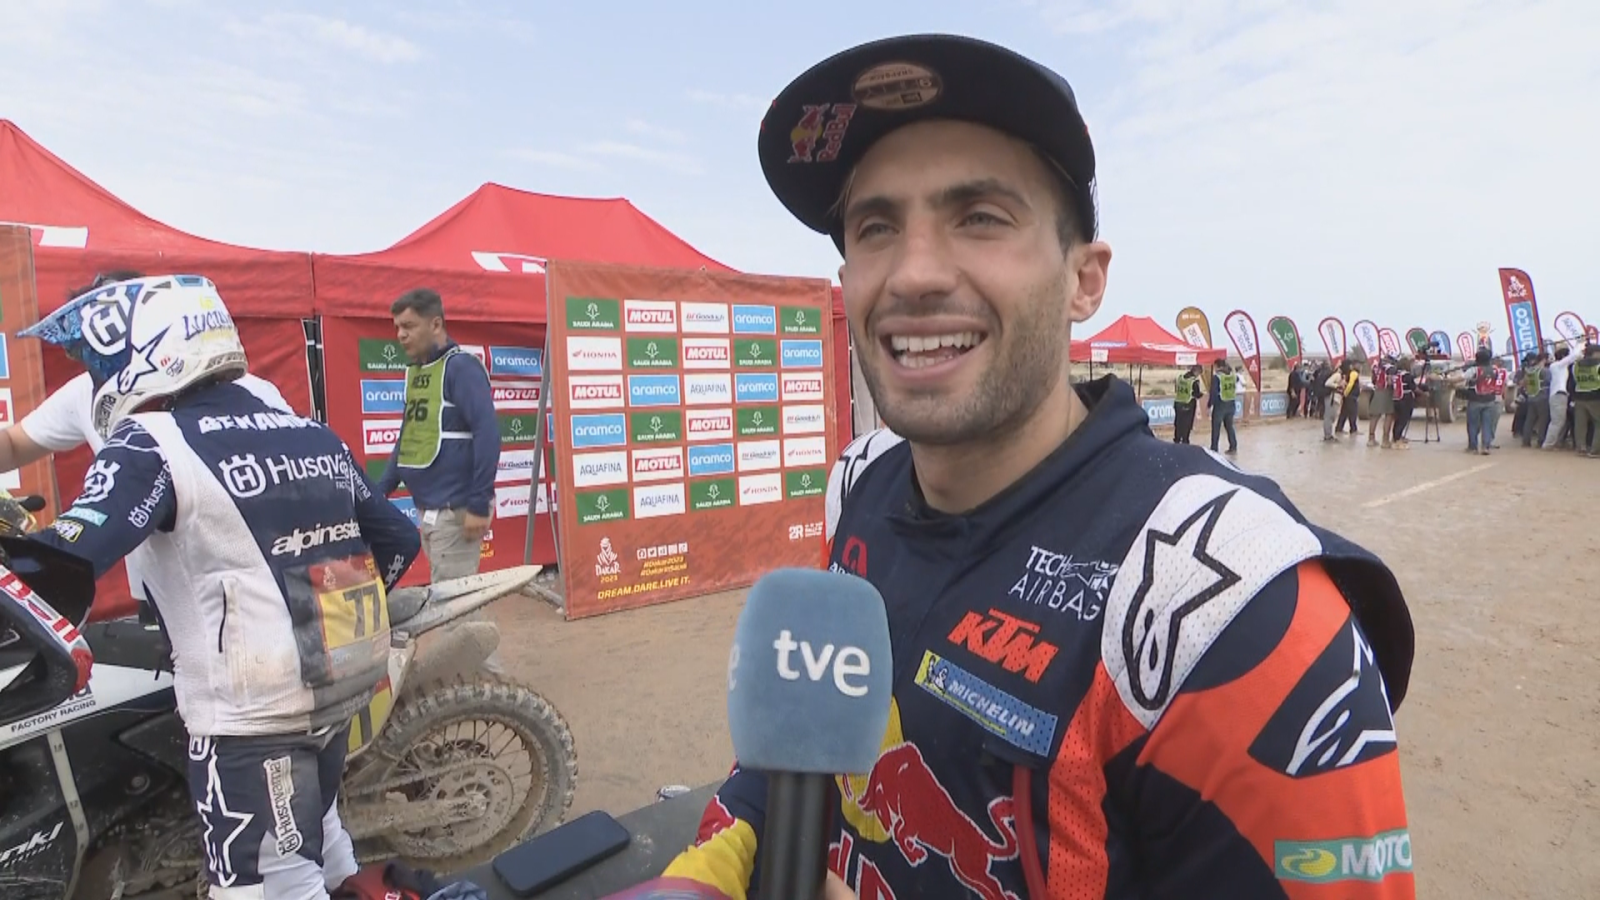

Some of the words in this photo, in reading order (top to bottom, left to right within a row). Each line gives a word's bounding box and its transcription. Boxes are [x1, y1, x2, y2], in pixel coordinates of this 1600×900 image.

[628, 310, 673, 324] MOTUL
[735, 314, 773, 325] aramco
[582, 351, 617, 359] HONDA
[687, 347, 727, 359] MOTUL
[783, 349, 820, 358] aramco
[367, 362, 386, 370] SAUDI
[494, 355, 538, 367] aramco
[574, 386, 620, 398] MOTUL
[632, 385, 677, 396] aramco
[690, 383, 727, 395] AQUAFINA
[738, 382, 776, 393] aramco
[785, 380, 820, 392] MOTUL
[366, 390, 403, 401] aram
[493, 388, 538, 400] MOTUL
[1148, 405, 1176, 419] aram
[575, 424, 622, 436] aramco
[690, 419, 730, 432] MOTUL
[369, 430, 400, 444] MOT
[637, 433, 654, 441] SAUDI
[655, 432, 676, 440] ARABIA
[636, 457, 680, 471] MOTUL
[691, 453, 732, 466] aramco
[580, 462, 622, 476] AQUAFINA
[751, 486, 778, 494] HONDA
[510, 498, 543, 506] HONA
[640, 494, 680, 507] AQUAFINA
[696, 501, 712, 509] SAUDI
[712, 499, 731, 507] ARABIA
[583, 515, 601, 523] SAUDI
[601, 511, 624, 520] ARABIA
[595, 561, 621, 577] DAKAR
[1008, 573, 1103, 621] AIRBAG
[343, 583, 381, 639] 77
[947, 608, 1059, 684] KTM
[773, 629, 871, 697] tve
[948, 679, 1035, 737] MICHELIN
[11, 711, 58, 733] FACTORY
[59, 699, 96, 716] RACING
[270, 761, 295, 838] Husqvarna
